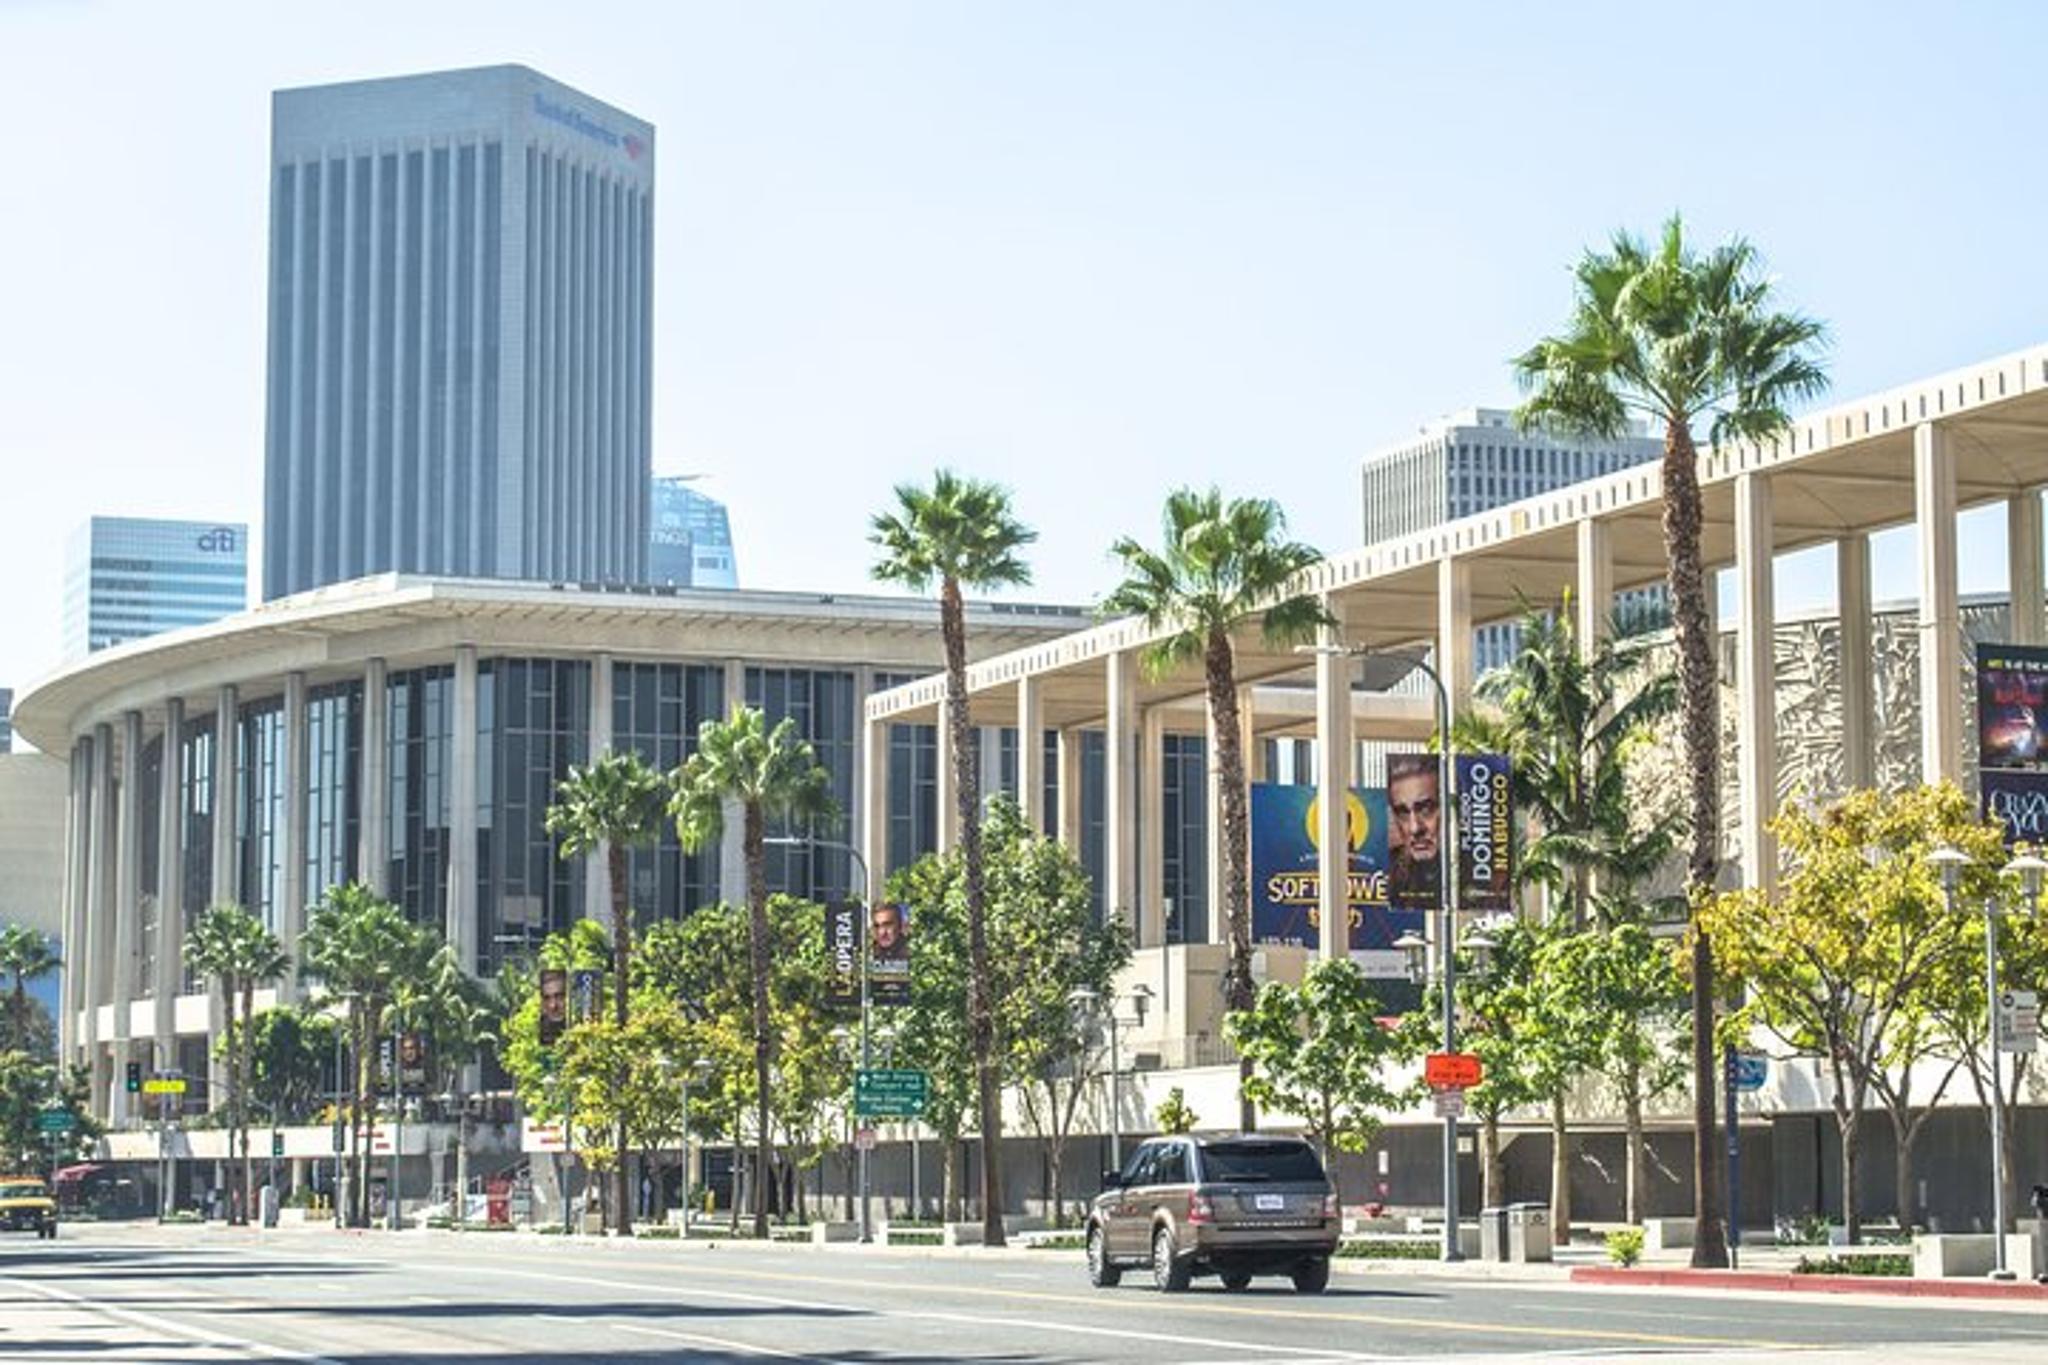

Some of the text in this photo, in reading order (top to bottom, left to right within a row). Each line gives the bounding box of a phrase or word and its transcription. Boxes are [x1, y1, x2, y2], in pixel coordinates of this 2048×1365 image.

[198, 528, 236, 552] citi
[1470, 762, 1492, 881] DOMINGO
[1493, 773, 1508, 871] NABUCCO
[1268, 877, 1320, 902] SOFT
